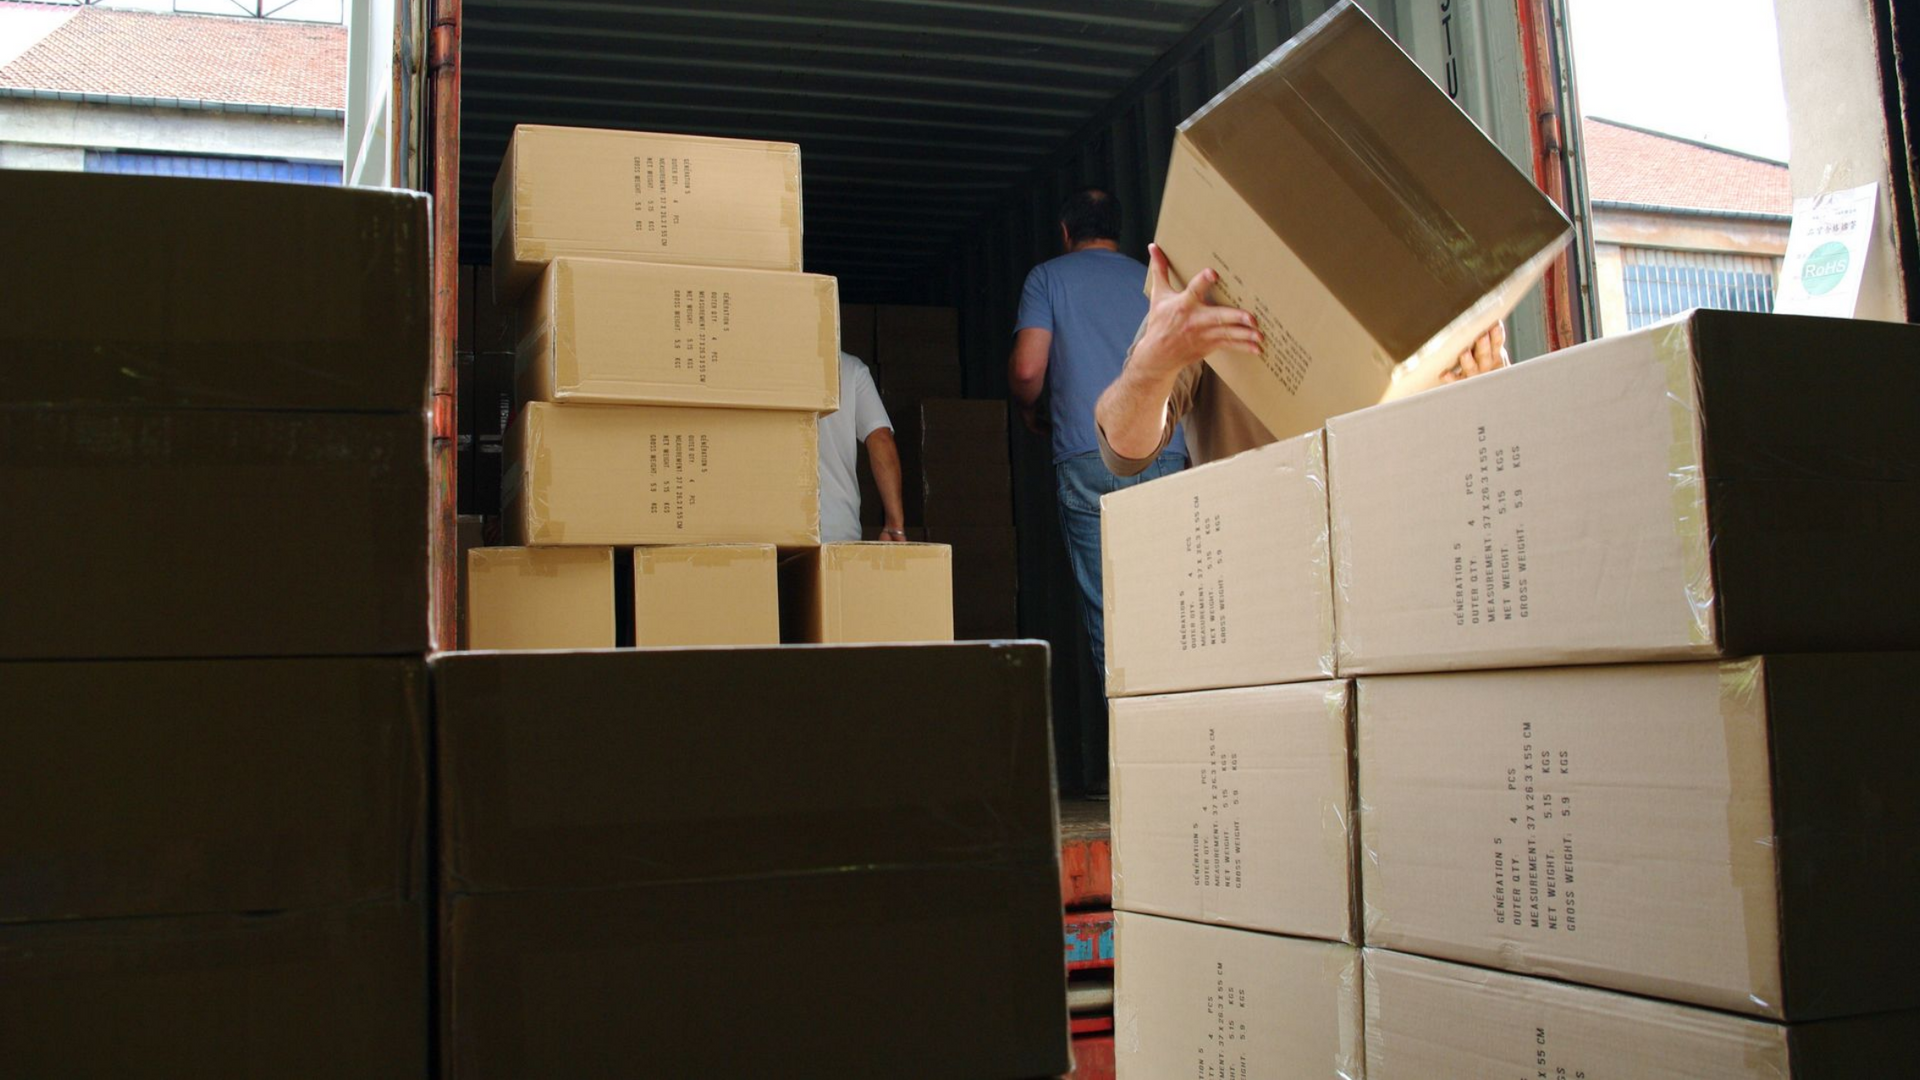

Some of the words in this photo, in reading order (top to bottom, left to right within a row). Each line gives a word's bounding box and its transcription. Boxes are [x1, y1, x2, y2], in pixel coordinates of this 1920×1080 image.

[1440, 0, 1458, 99] TU
[1804, 258, 1847, 279] RoHS
[700, 374, 706, 382] CM
[1478, 426, 1485, 442] CM
[1480, 447, 1487, 462] 55
[1496, 449, 1504, 471] KGS
[1512, 445, 1520, 468] KGS
[1465, 473, 1473, 495] PCS
[1481, 476, 1490, 501] 26.3
[1194, 496, 1199, 508] CM
[1514, 489, 1523, 509] 5.9
[677, 521, 683, 529] CM
[1194, 511, 1200, 523] 55
[1483, 515, 1492, 529] 37
[1197, 568, 1203, 579] 37
[1453, 556, 1464, 626] GÉNÉRATION
[1519, 578, 1528, 618] GROSS
[1470, 587, 1479, 624] OUTER
[1504, 597, 1512, 620] NET
[1209, 728, 1215, 741] CM
[1523, 721, 1532, 739] CM
[1210, 745, 1216, 757] 55
[1524, 744, 1533, 760] 55
[1542, 750, 1550, 774] KGS
[1560, 750, 1568, 774] KGS
[1508, 768, 1517, 791] PCS
[1525, 774, 1535, 800] 26.3
[1212, 804, 1218, 816] 37
[1544, 794, 1552, 819] 5.15
[1562, 796, 1571, 817] 5.9
[1527, 815, 1536, 830] 37
[1493, 852, 1505, 924] GÉNÉRATION
[1513, 887, 1522, 926] OUTER
[1565, 890, 1576, 931] GROSS
[1549, 906, 1558, 930] NET
[1217, 962, 1223, 976] CM
[1217, 980, 1224, 992] 55
[1219, 1035, 1225, 1047] 37
[1536, 1027, 1545, 1045] CM
[1536, 1050, 1546, 1065] 55
